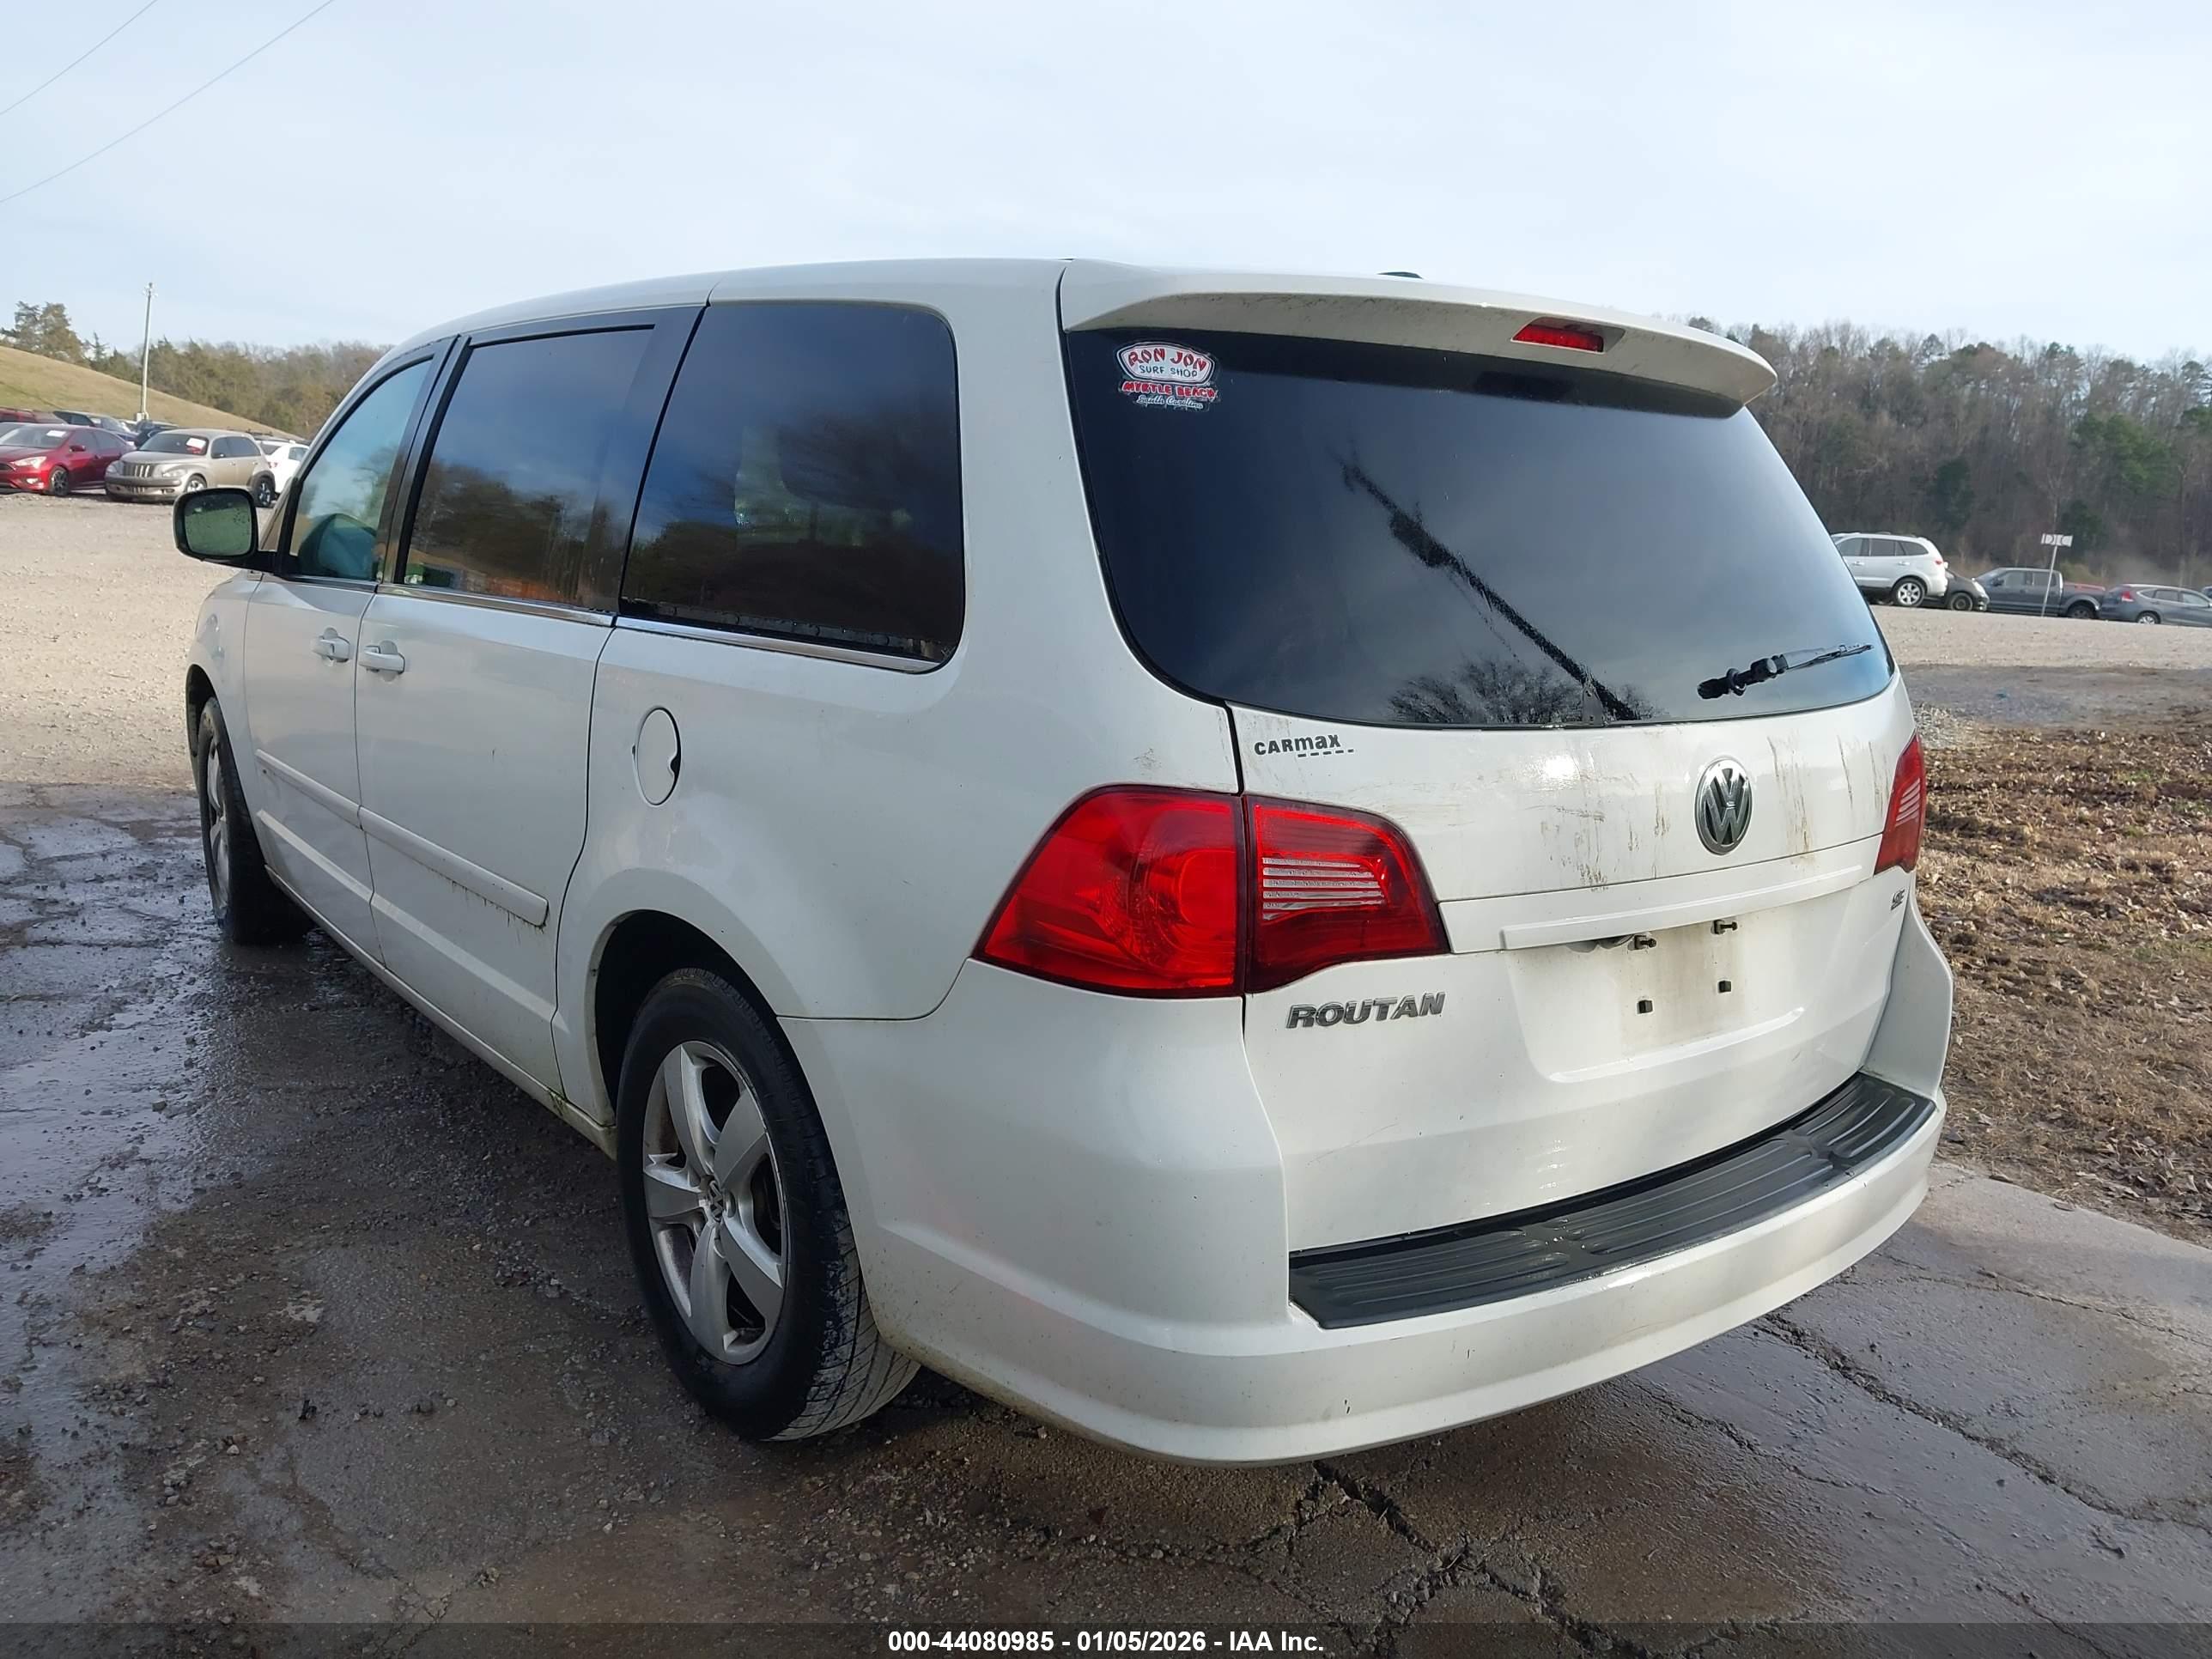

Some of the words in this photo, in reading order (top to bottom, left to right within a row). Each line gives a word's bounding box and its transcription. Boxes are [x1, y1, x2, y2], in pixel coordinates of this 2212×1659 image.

[1128, 348, 1165, 367] RON
[1170, 351, 1206, 371] JON
[1139, 365, 1164, 374] SURF
[1170, 368, 1198, 378] SHOP
[1122, 381, 1172, 394] MYRTLE
[1176, 386, 1216, 398] BEACH
[1286, 992, 1446, 1030] ROUTAN
